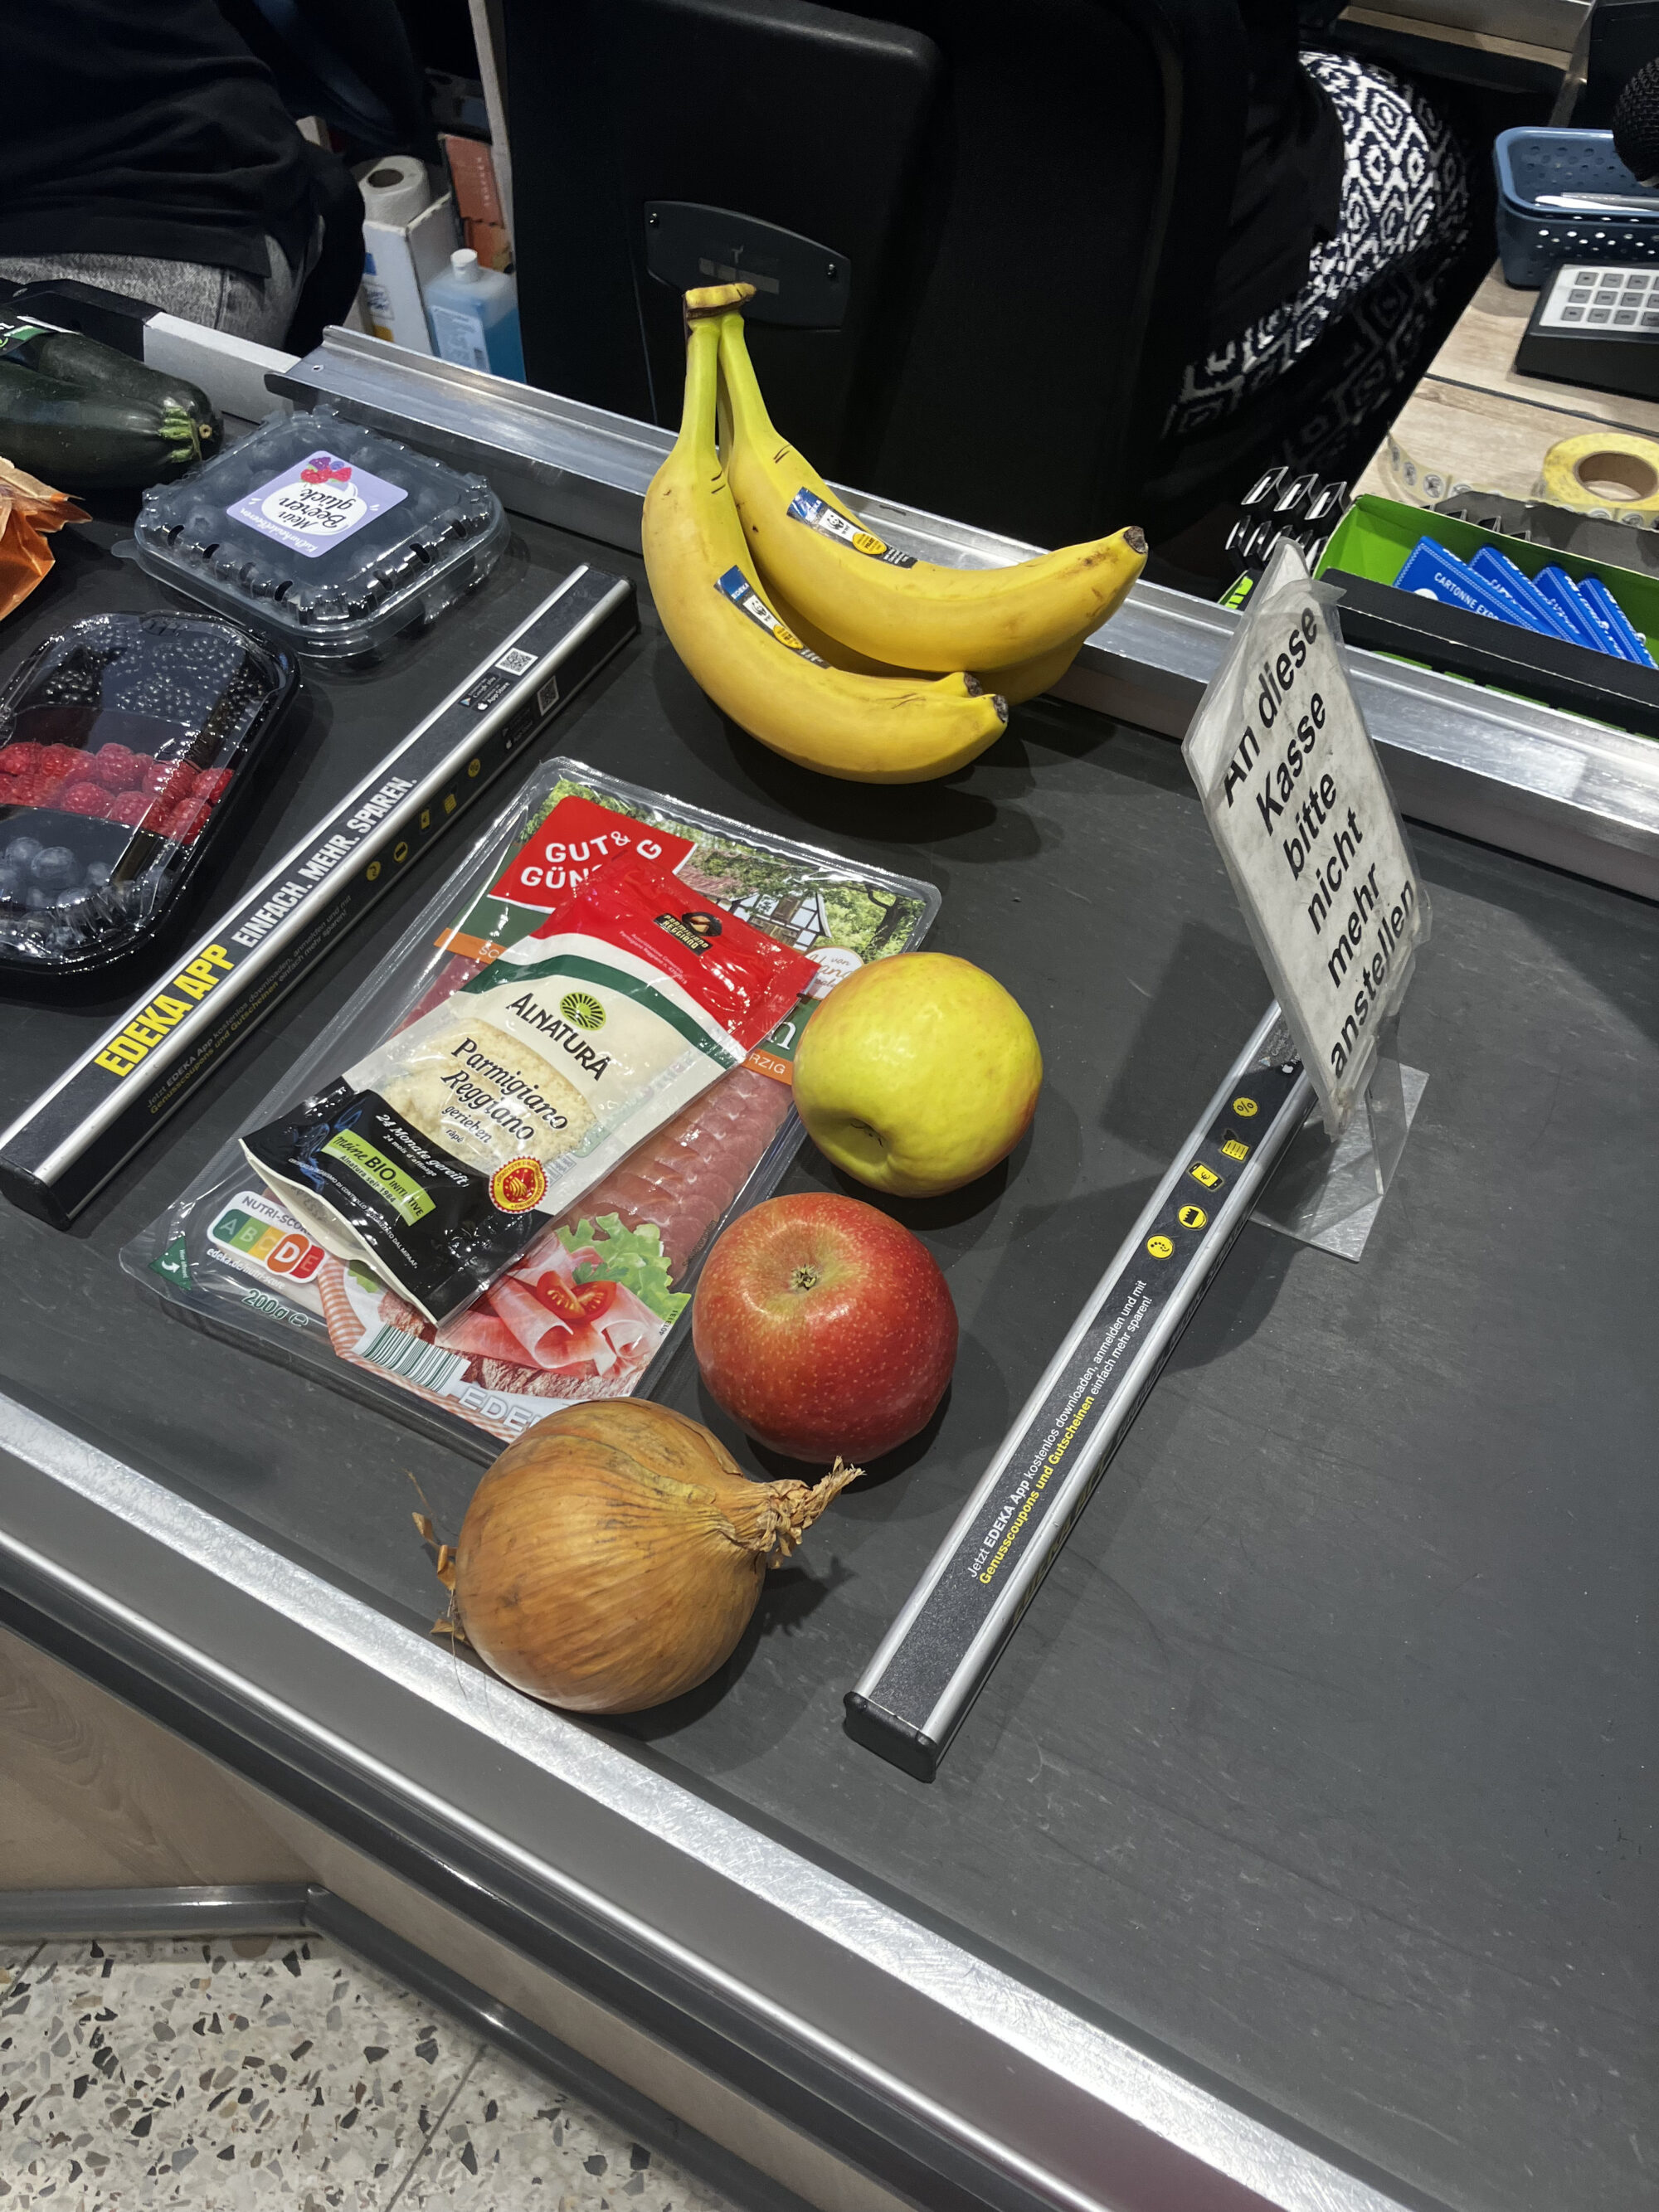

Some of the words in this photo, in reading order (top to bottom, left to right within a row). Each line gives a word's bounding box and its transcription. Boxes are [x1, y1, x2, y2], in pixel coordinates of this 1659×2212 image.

[278, 510, 319, 530] Mein
[279, 496, 348, 528] Beeren
[299, 488, 357, 511] glück
[1433, 571, 1477, 612] CARTONNE
[1224, 725, 1260, 809] An
[1258, 607, 1317, 728] diese
[1256, 693, 1326, 836] Kasse
[545, 834, 609, 863] GUT
[1282, 773, 1336, 882] bitte
[1307, 805, 1363, 935] nicht
[94, 994, 194, 1078] EDEKA
[173, 943, 235, 1000] APP
[231, 880, 314, 948] EINFACH.
[298, 833, 361, 889] MEHR.
[346, 775, 417, 834] SPAREN.
[663, 914, 709, 949] PARMIGIANO
[663, 920, 699, 950] REGGIANO
[1327, 862, 1380, 989] mehr
[830, 956, 850, 966] von
[1331, 879, 1414, 1079] anstellen
[165, 1057, 197, 1087] EDEKA
[197, 1039, 213, 1056] App
[450, 1037, 568, 1130] Parmigiano
[440, 1069, 536, 1140] Reggiano
[441, 1106, 492, 1144] gerieben
[333, 1135, 370, 1161] meine
[364, 1155, 397, 1182] BIO
[376, 1114, 397, 1127] 24
[388, 1127, 431, 1160] Monate
[382, 1134, 394, 1142] 24
[392, 1141, 407, 1154] mois
[446, 1129, 464, 1144] râpé
[339, 1155, 367, 1180] Alnatura
[365, 1176, 380, 1189] seit
[380, 1187, 397, 1203] 1984
[274, 1241, 301, 1263] D
[392, 1237, 401, 1249] DAL
[207, 1246, 285, 1291] edeka.de/nutri-score
[241, 1288, 289, 1320] 200g
[967, 1548, 990, 1578] Jetzt
[985, 1504, 1016, 1548] EDEKA
[1012, 1479, 1032, 1506] App
[1026, 1428, 1061, 1480] kostenlos
[1056, 1364, 1098, 1428] downloaden,
[1094, 1315, 1125, 1364] anmelden
[1122, 1295, 1139, 1317] und
[1134, 1278, 1148, 1297] mit
[979, 1490, 1041, 1585] Genusscoupons
[1036, 1465, 1054, 1490] und
[1048, 1395, 1095, 1466] Gutscheinen
[1090, 1359, 1117, 1396] einfach
[1112, 1331, 1131, 1360] mehr
[1126, 1295, 1153, 1333] sparen!
